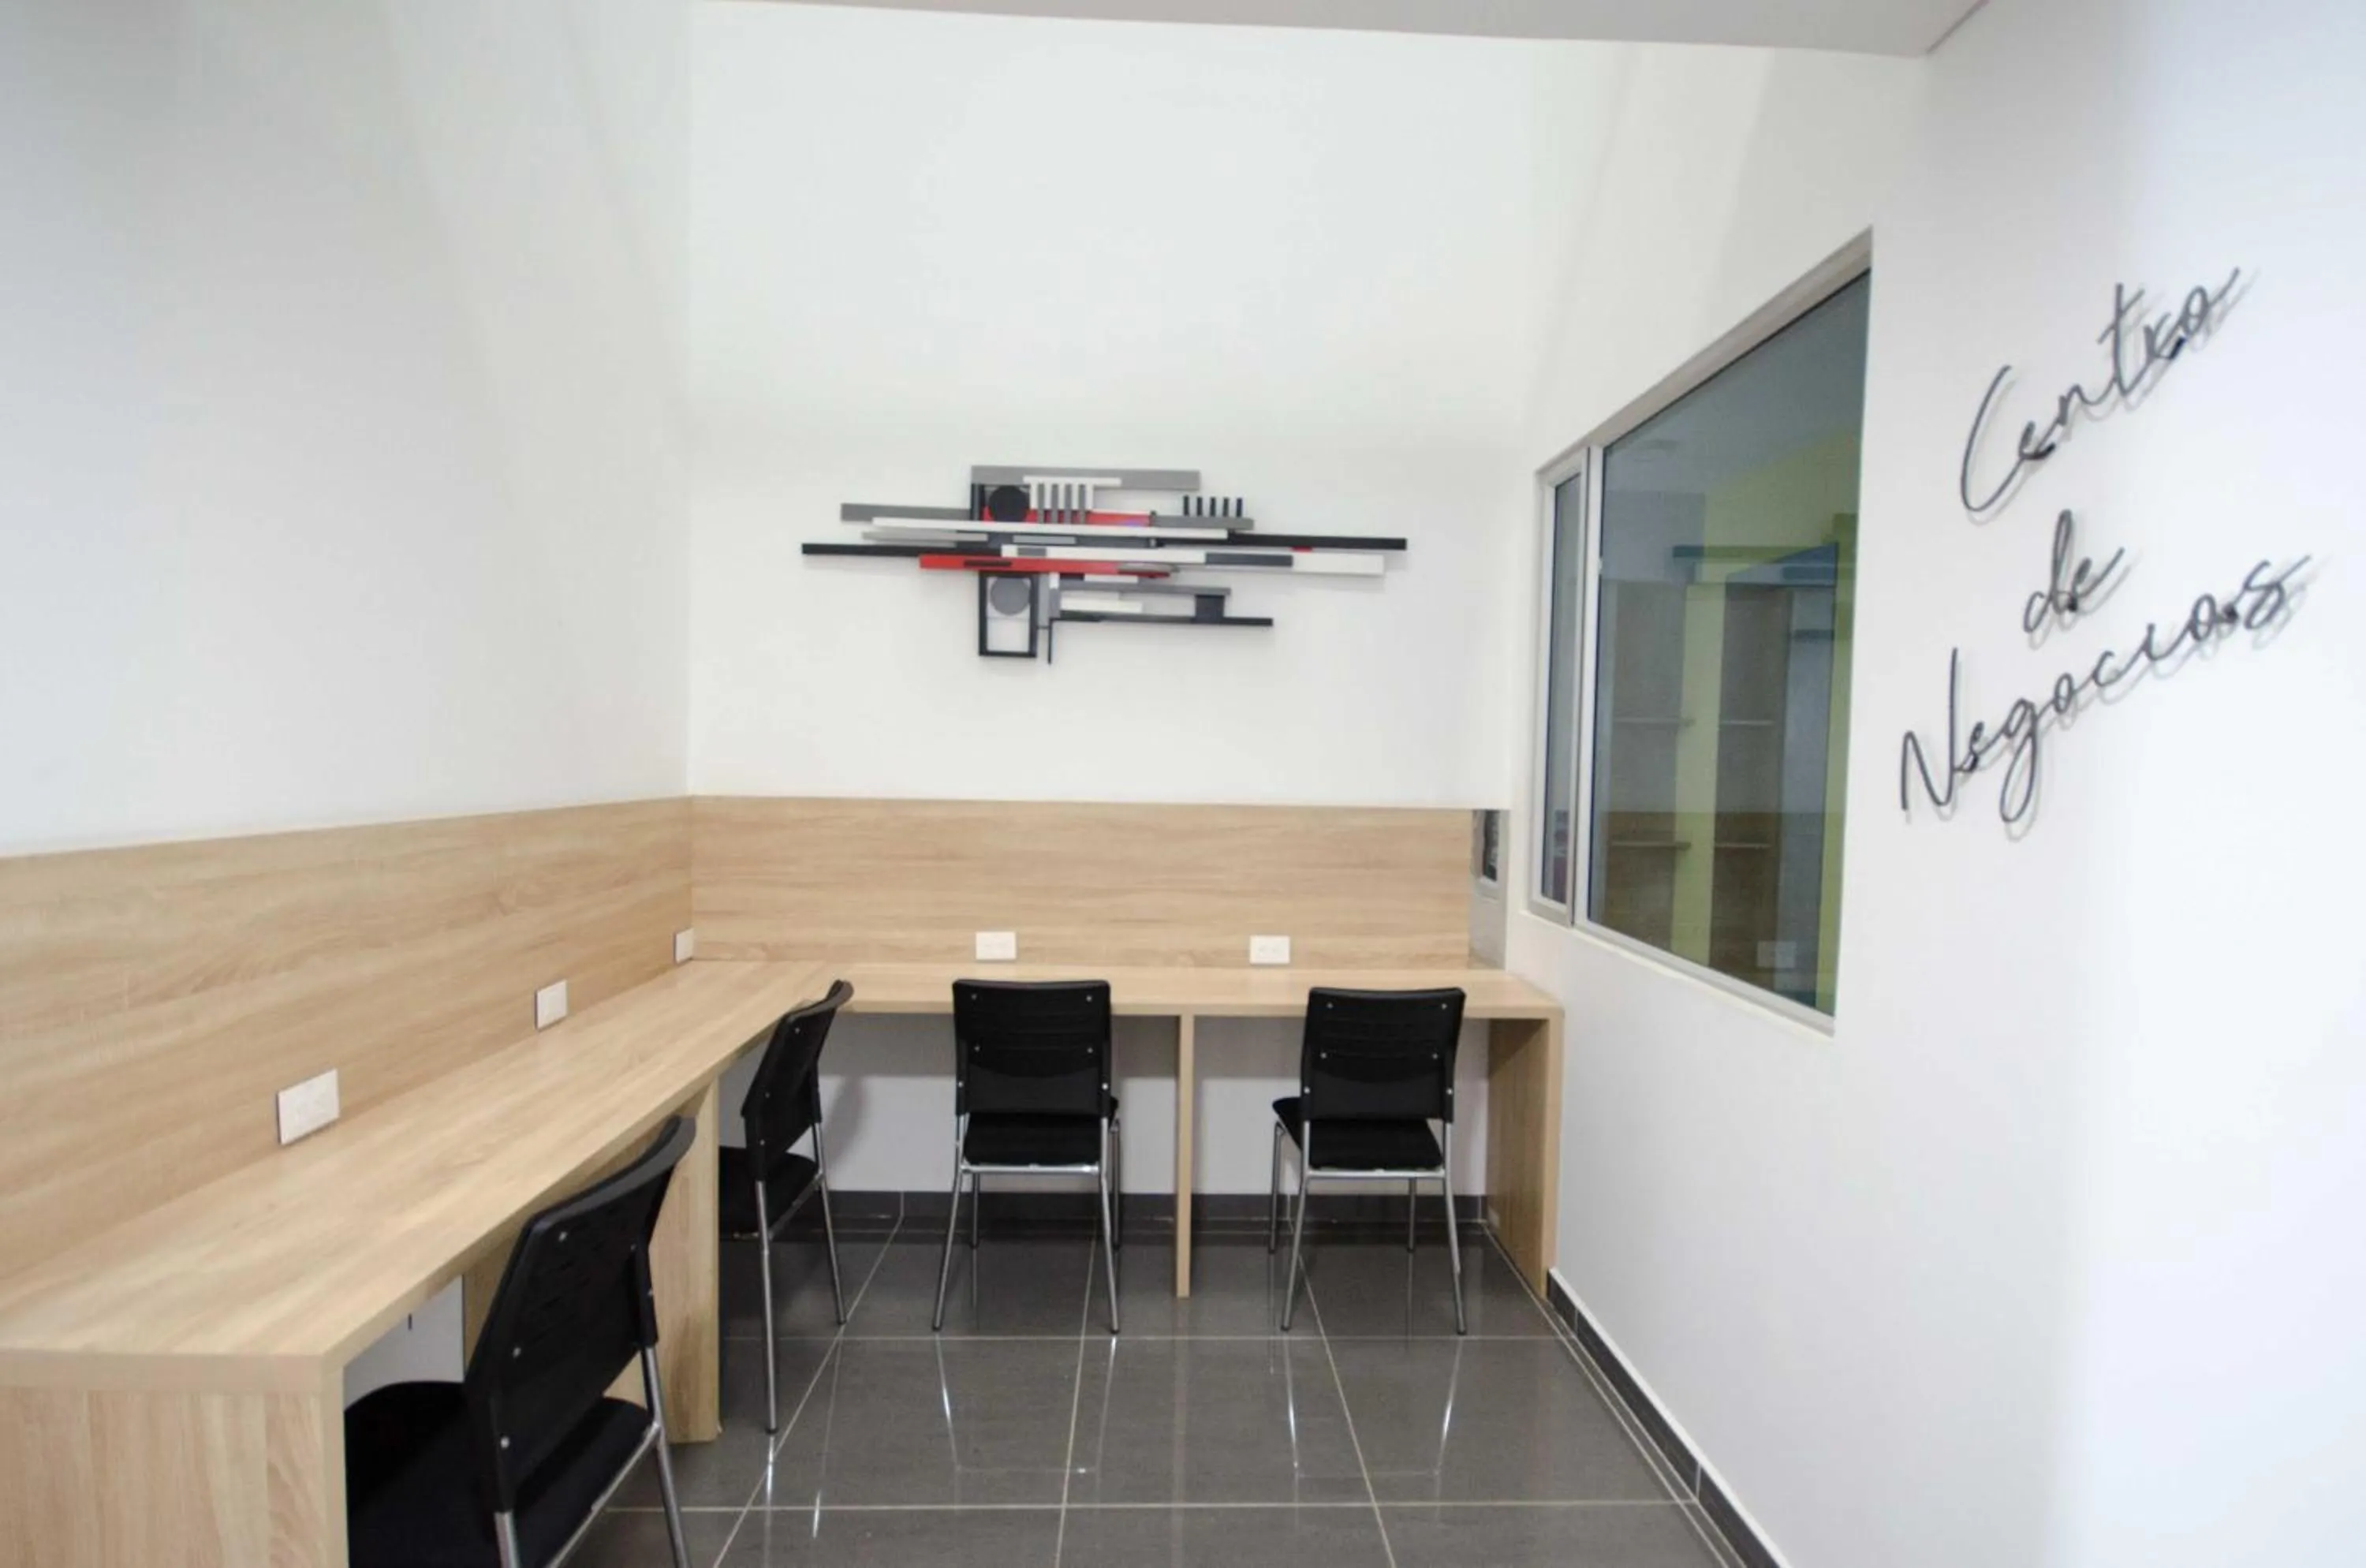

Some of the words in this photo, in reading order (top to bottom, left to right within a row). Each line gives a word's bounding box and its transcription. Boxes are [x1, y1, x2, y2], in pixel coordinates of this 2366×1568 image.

[1961, 267, 2240, 513] Centro
[1901, 554, 2312, 823] Negocios
[2024, 509, 2125, 633] de
